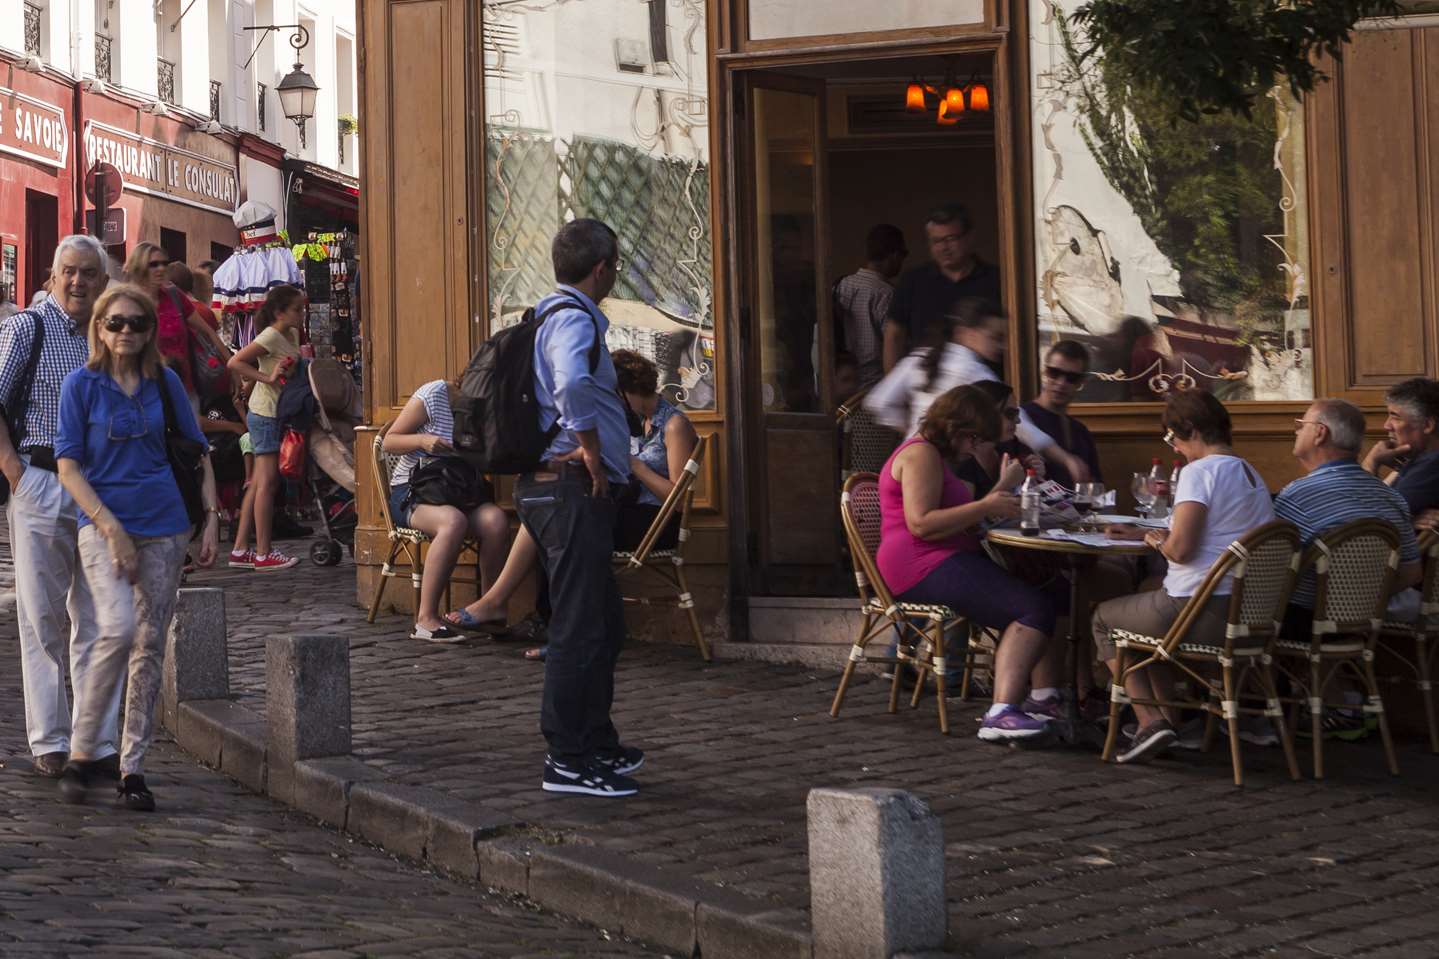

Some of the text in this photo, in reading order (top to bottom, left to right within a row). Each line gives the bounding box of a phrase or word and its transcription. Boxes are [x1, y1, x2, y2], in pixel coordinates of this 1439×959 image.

[15, 108, 63, 152] SAVOIE
[89, 135, 235, 203] RESTAURANT LE CONSULAT
